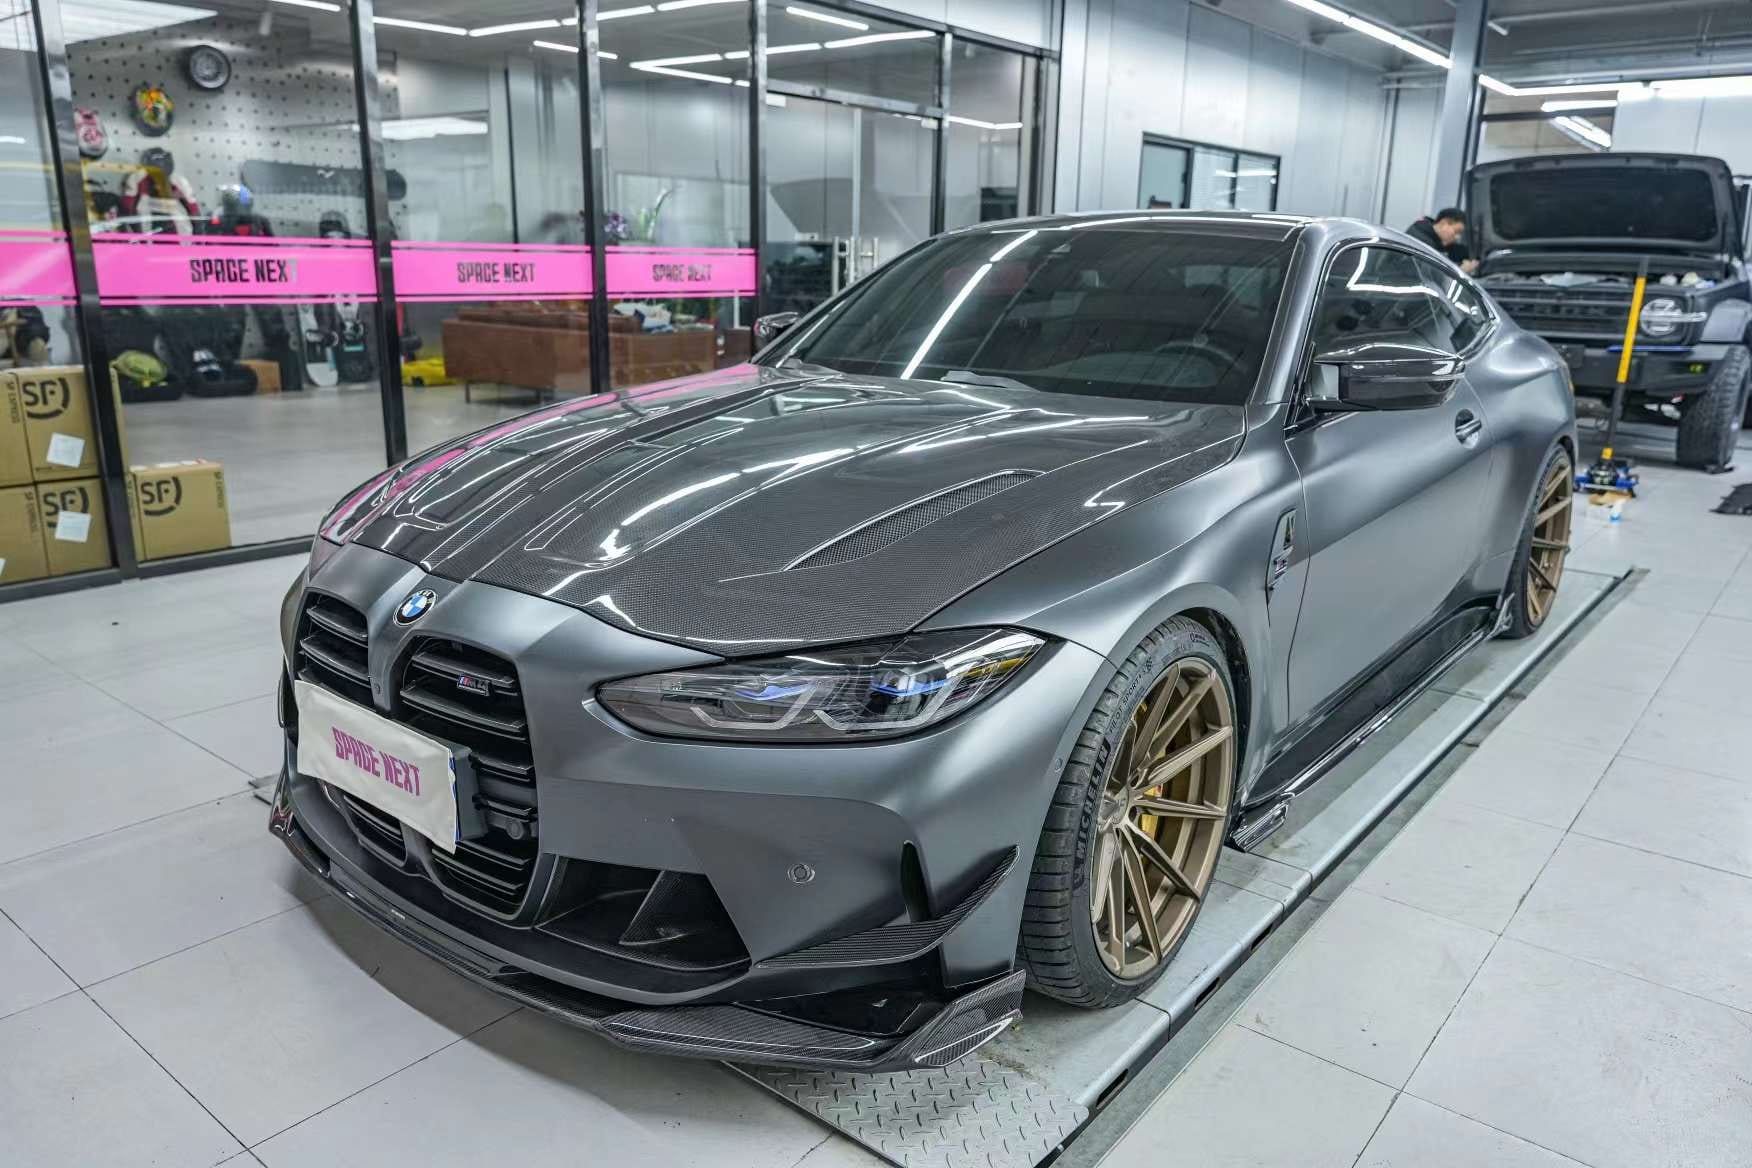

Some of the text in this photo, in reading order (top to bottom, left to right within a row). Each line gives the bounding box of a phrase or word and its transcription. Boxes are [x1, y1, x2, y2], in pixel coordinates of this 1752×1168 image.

[189, 258, 299, 283] SPACE NEXT
[456, 261, 536, 284] SPACE NEXT
[651, 263, 686, 283] SPACE
[331, 726, 421, 797] SPACE NEXT
[1075, 744, 1109, 861] MICHELIN
